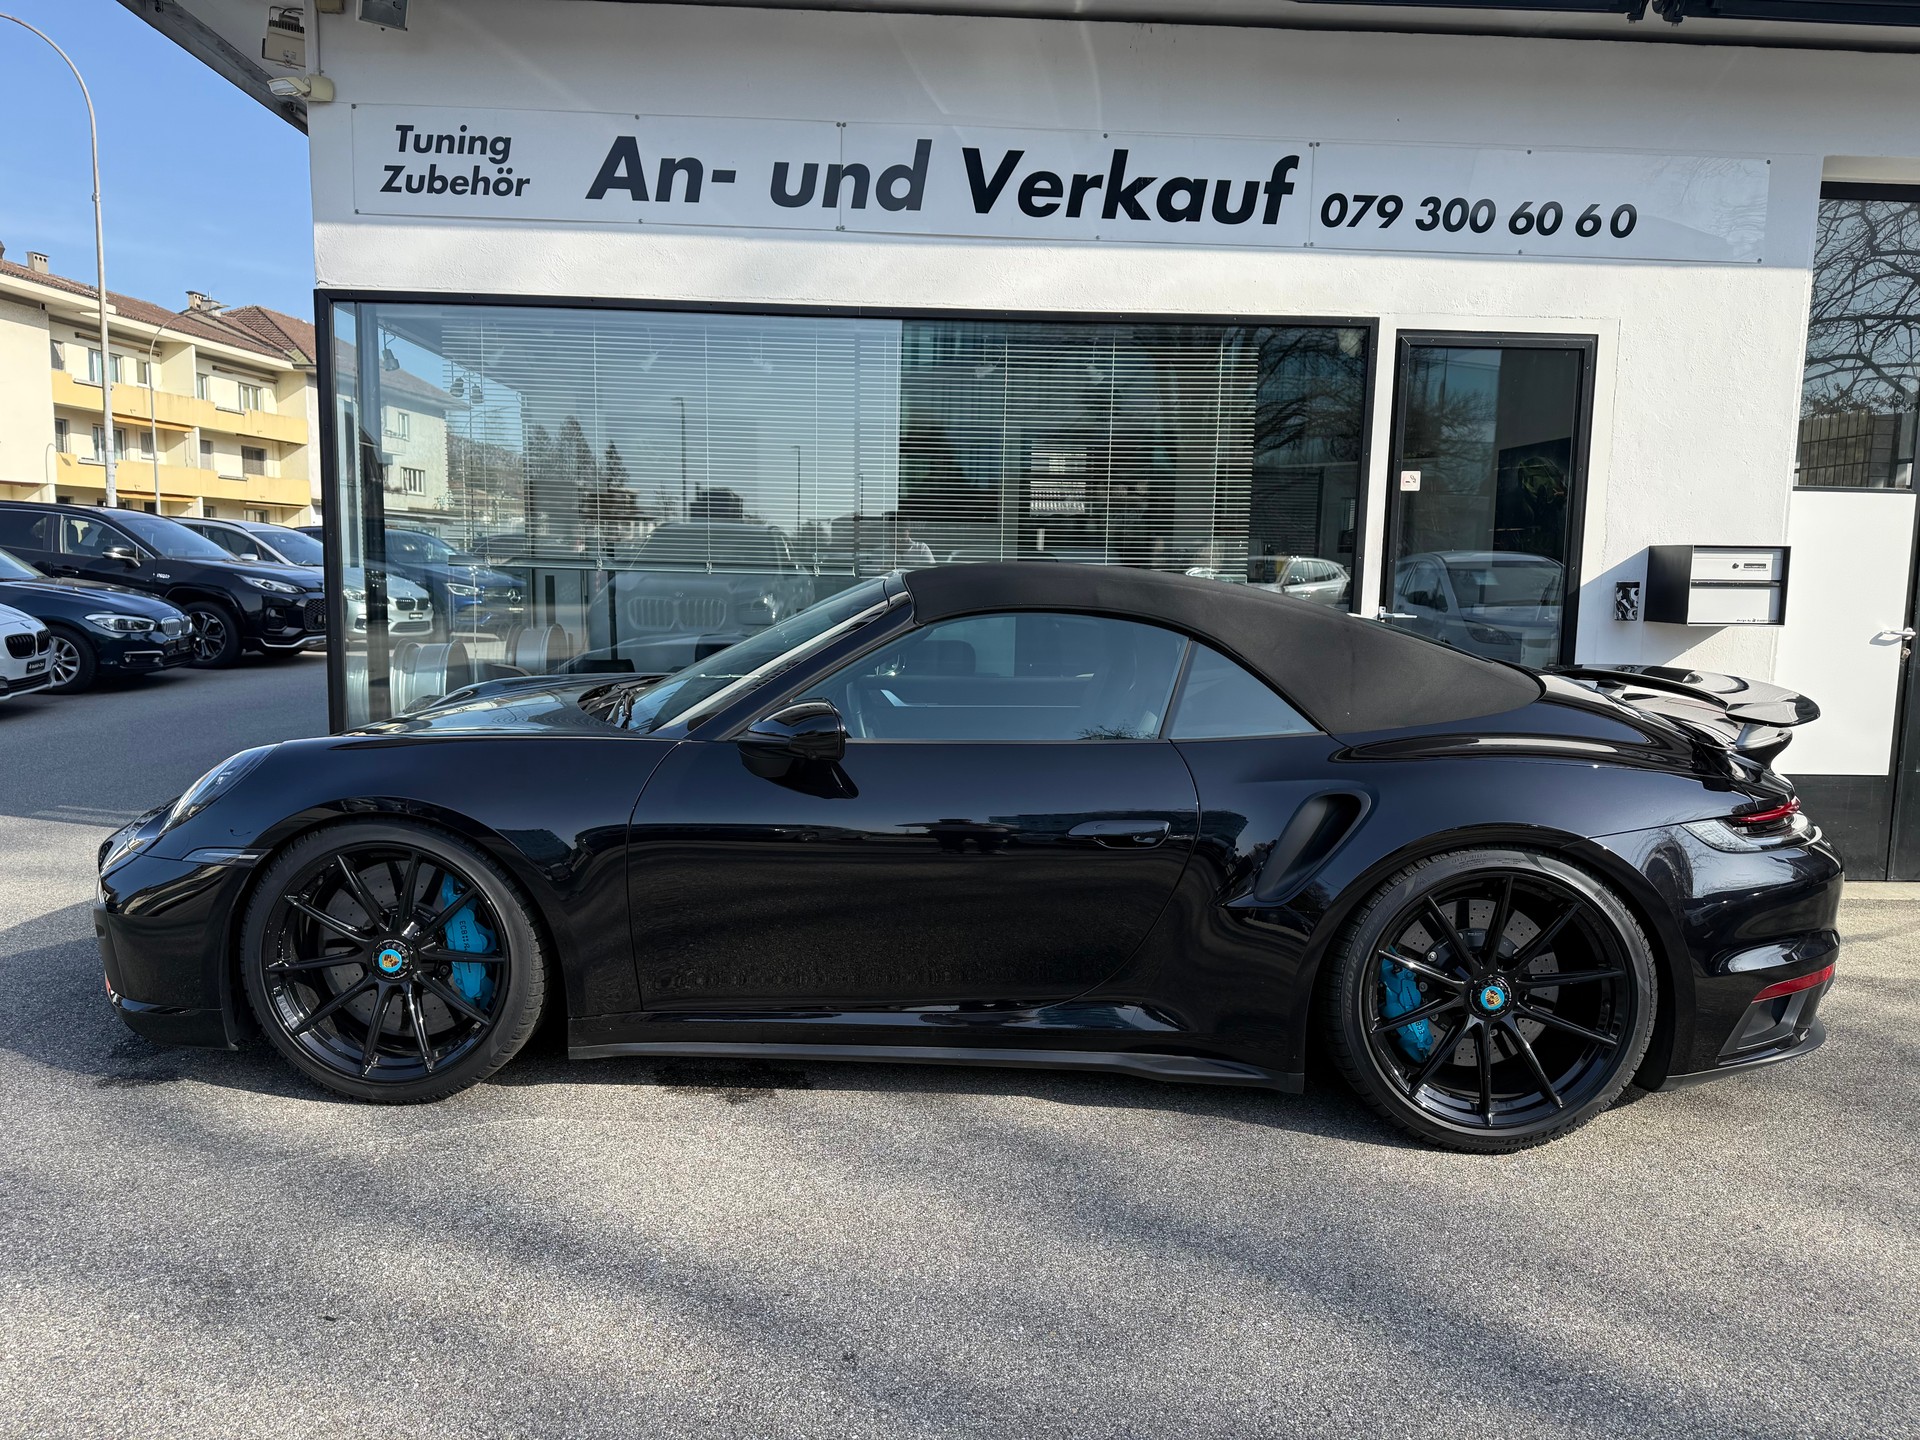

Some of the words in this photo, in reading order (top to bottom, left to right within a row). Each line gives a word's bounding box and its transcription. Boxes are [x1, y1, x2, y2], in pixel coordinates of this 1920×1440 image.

[395, 124, 512, 165] Tuning
[379, 163, 531, 197] Zubehör
[585, 135, 737, 203] An-
[770, 138, 933, 212] und
[961, 147, 1300, 225] Verkauf
[1320, 193, 1404, 229] 079
[1415, 196, 1496, 234] 300
[1508, 201, 1564, 236] 60
